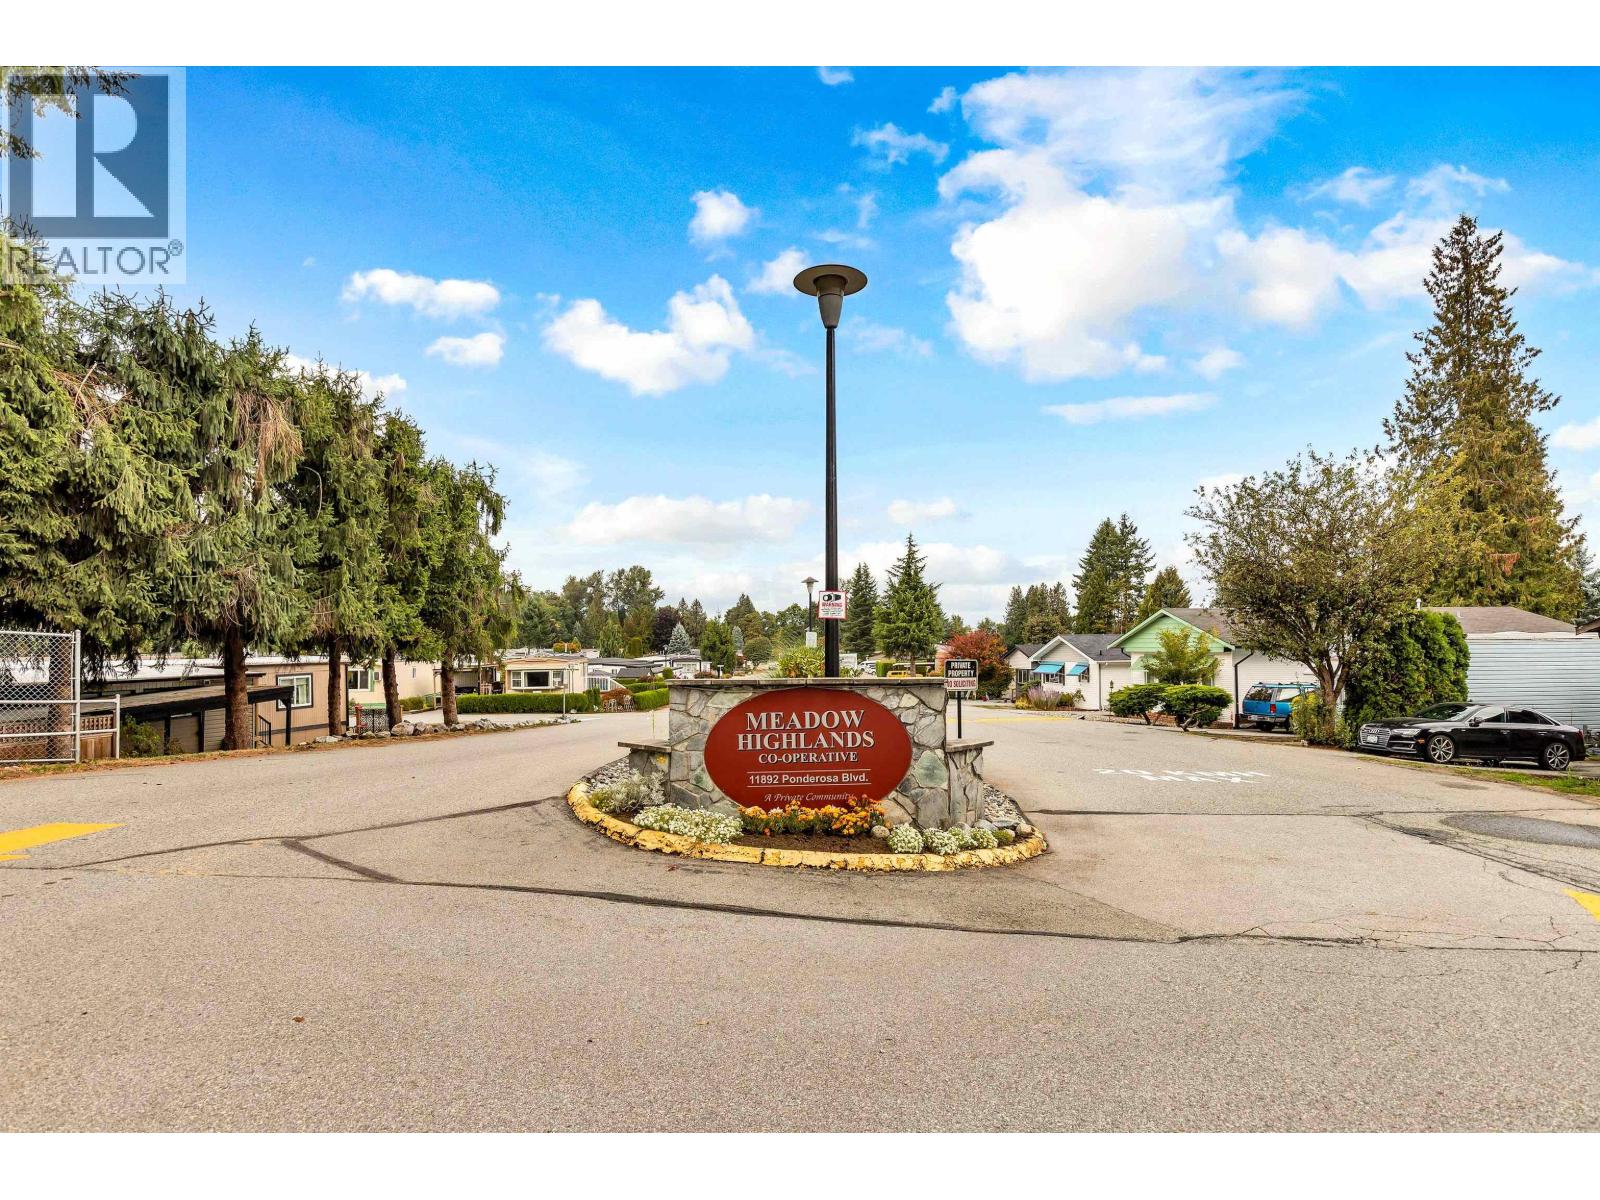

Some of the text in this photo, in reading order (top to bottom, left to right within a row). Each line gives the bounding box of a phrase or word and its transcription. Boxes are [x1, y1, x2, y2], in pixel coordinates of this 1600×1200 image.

[950, 661, 971, 669] PRIVATE
[947, 669, 975, 677] PROPERTY
[953, 680, 976, 688] SOLICITING
[745, 709, 865, 731] MEADOW
[736, 730, 875, 751] HIGHLANDS
[758, 751, 858, 764] CO-OPERATIVE
[749, 772, 869, 784] 11892 Ponderosa Blvd.
[764, 793, 772, 802] A
[774, 793, 804, 802] Private
